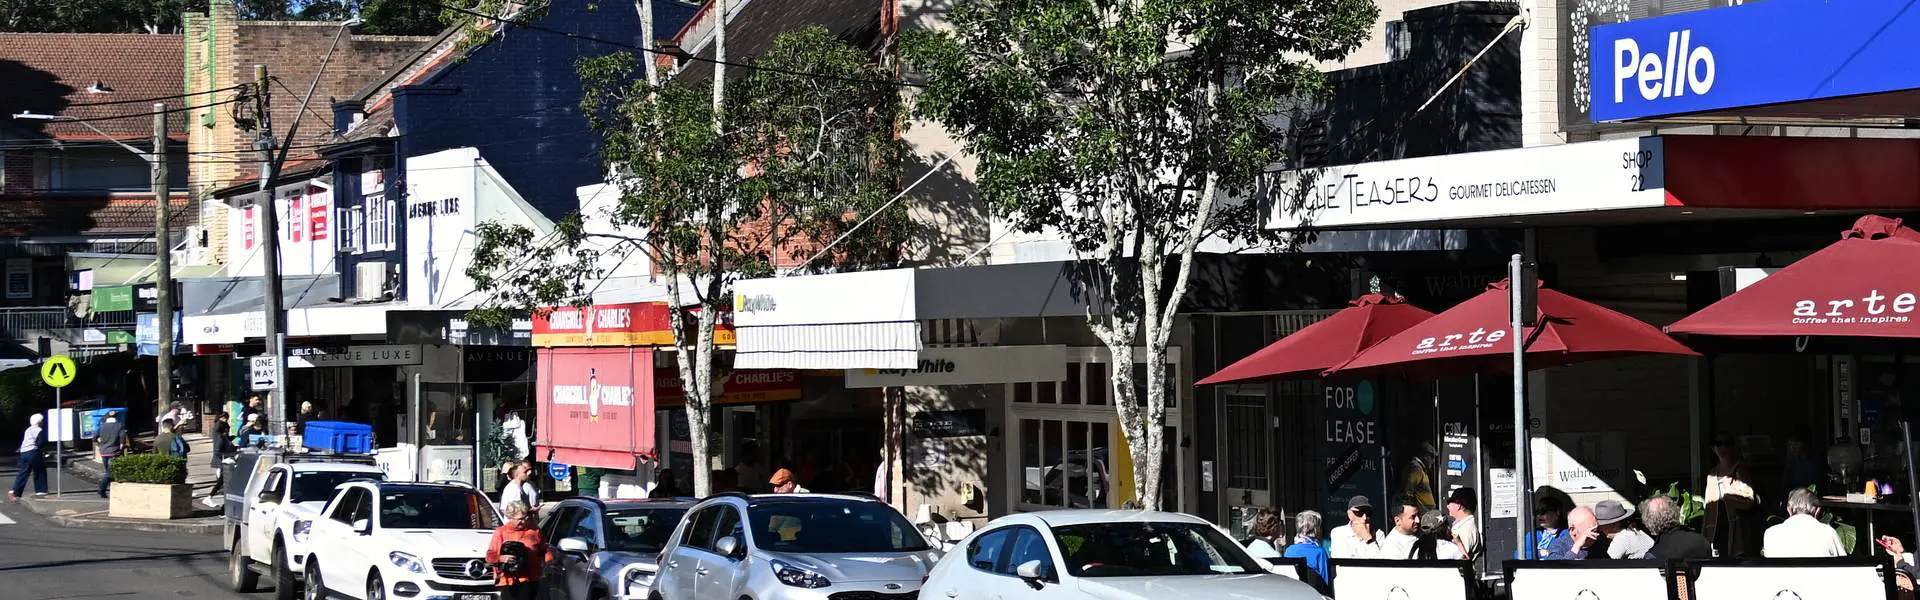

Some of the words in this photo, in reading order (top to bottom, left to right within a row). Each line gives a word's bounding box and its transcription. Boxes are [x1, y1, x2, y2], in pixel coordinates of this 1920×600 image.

[1614, 29, 1716, 104] Pello
[1622, 150, 1653, 170] SHOP
[1631, 174, 1645, 192] 22
[1343, 174, 1439, 214] TEASERS
[1448, 183, 1494, 200] GOURMET
[1495, 178, 1556, 197] DELICATESSEN
[440, 197, 460, 216] LUXE
[1793, 289, 1917, 316] arte
[1416, 327, 1506, 350] arte
[289, 347, 311, 356] UBLIC
[372, 350, 412, 360] LUXE
[468, 351, 524, 361] AVENUE
[255, 359, 273, 367] ONE
[254, 369, 275, 378] WAY
[735, 371, 795, 385] CHARLIE'S
[1325, 386, 1355, 409] FOR
[1325, 420, 1375, 444] LEASE
[1328, 464, 1345, 485] UNDER
